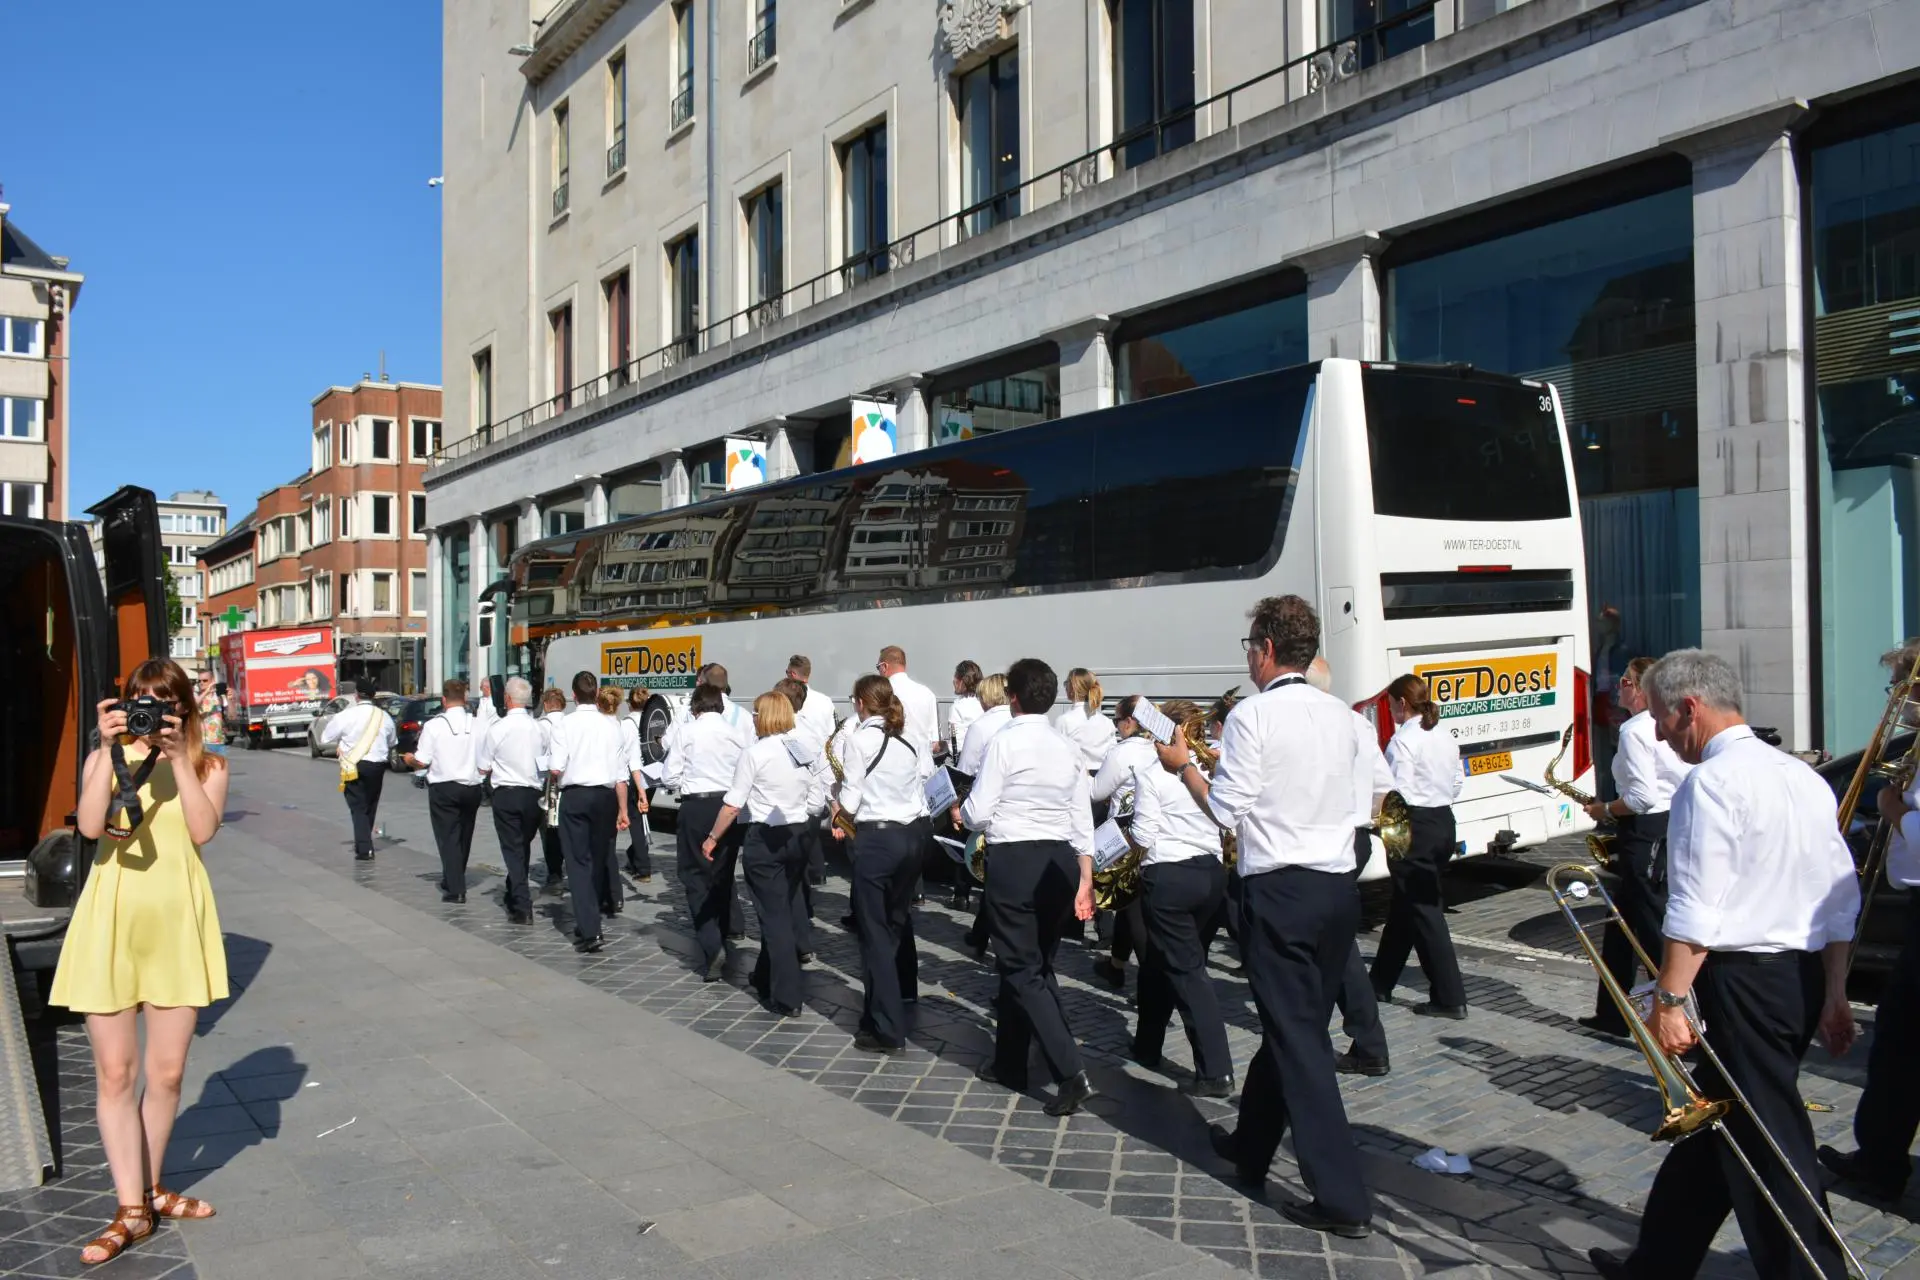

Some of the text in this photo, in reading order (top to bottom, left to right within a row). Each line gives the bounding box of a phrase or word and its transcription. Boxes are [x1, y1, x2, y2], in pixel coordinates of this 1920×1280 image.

[1538, 395, 1552, 412] 36
[1443, 538, 1522, 551] WWW.TER-DOEST.NL
[606, 643, 697, 676] Ter Doest
[648, 676, 688, 688] HENGEVELDE
[1421, 663, 1552, 703] Ter Doest
[1439, 694, 1542, 717] URINGCARS HENGEVELDE
[1460, 725, 1474, 738] +31
[1477, 723, 1491, 735] 547
[1499, 721, 1509, 733] 33
[1511, 719, 1520, 731] 33
[1522, 718, 1532, 729] 68
[1471, 753, 1511, 772] 84-BGZ-5
